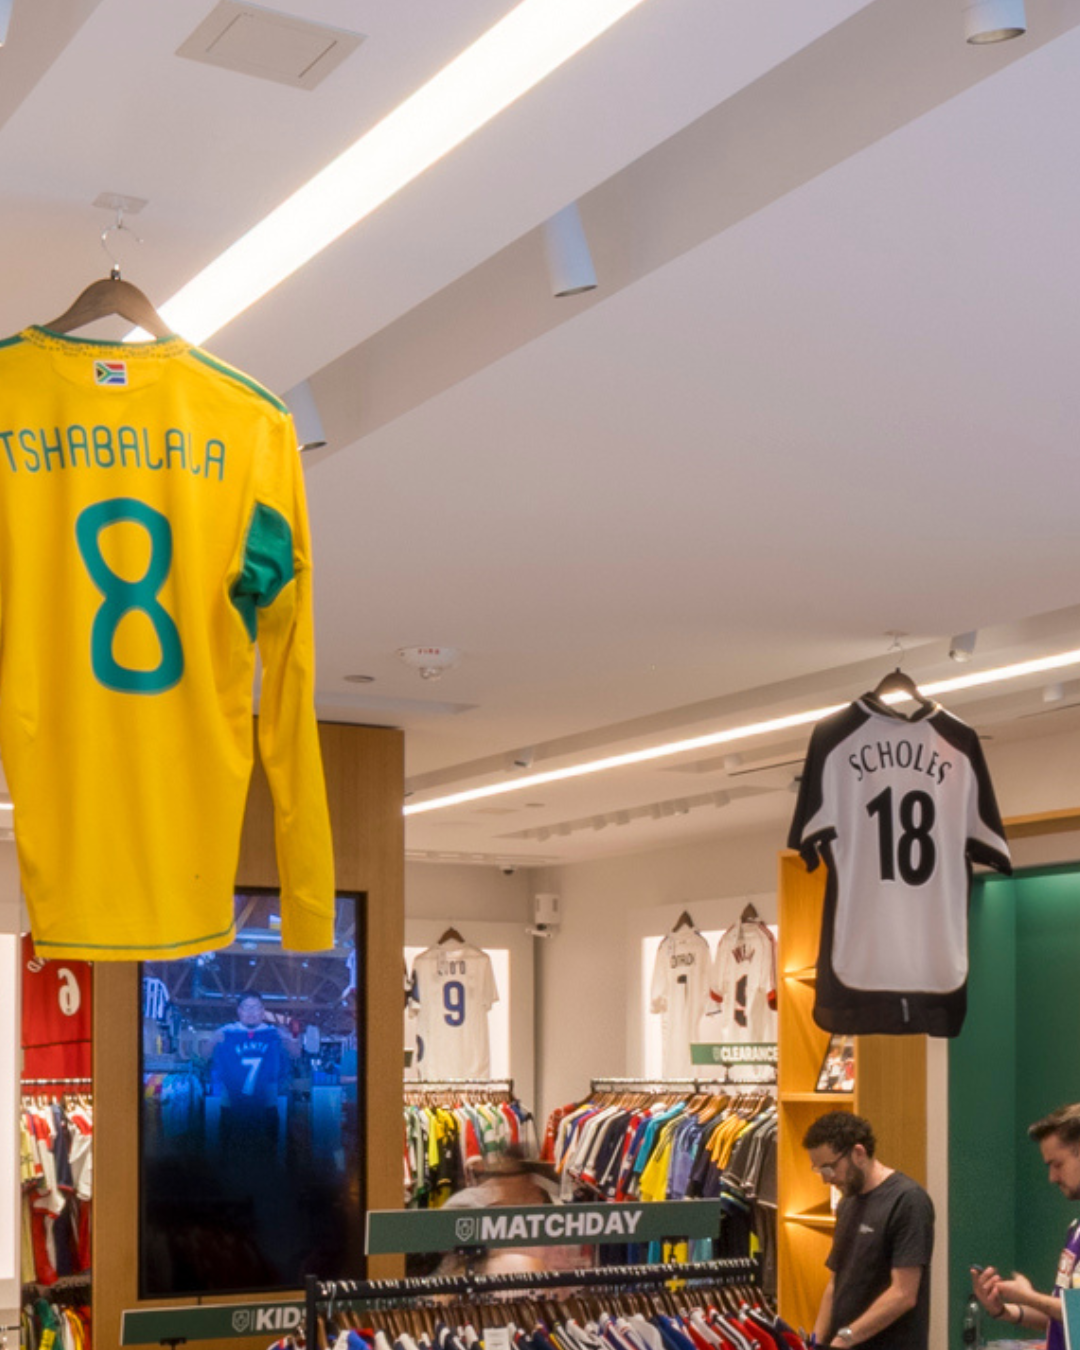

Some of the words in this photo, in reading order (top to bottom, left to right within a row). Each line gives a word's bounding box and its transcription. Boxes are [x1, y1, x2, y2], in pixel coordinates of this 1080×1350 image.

[0, 423, 226, 481] TSHABALALA
[74, 496, 185, 696] 8
[849, 740, 952, 785] SCHOLES
[866, 786, 936, 886] 18
[443, 980, 466, 1028] 9
[241, 1057, 263, 1095] 7
[481, 1210, 643, 1241] MATCHDAY
